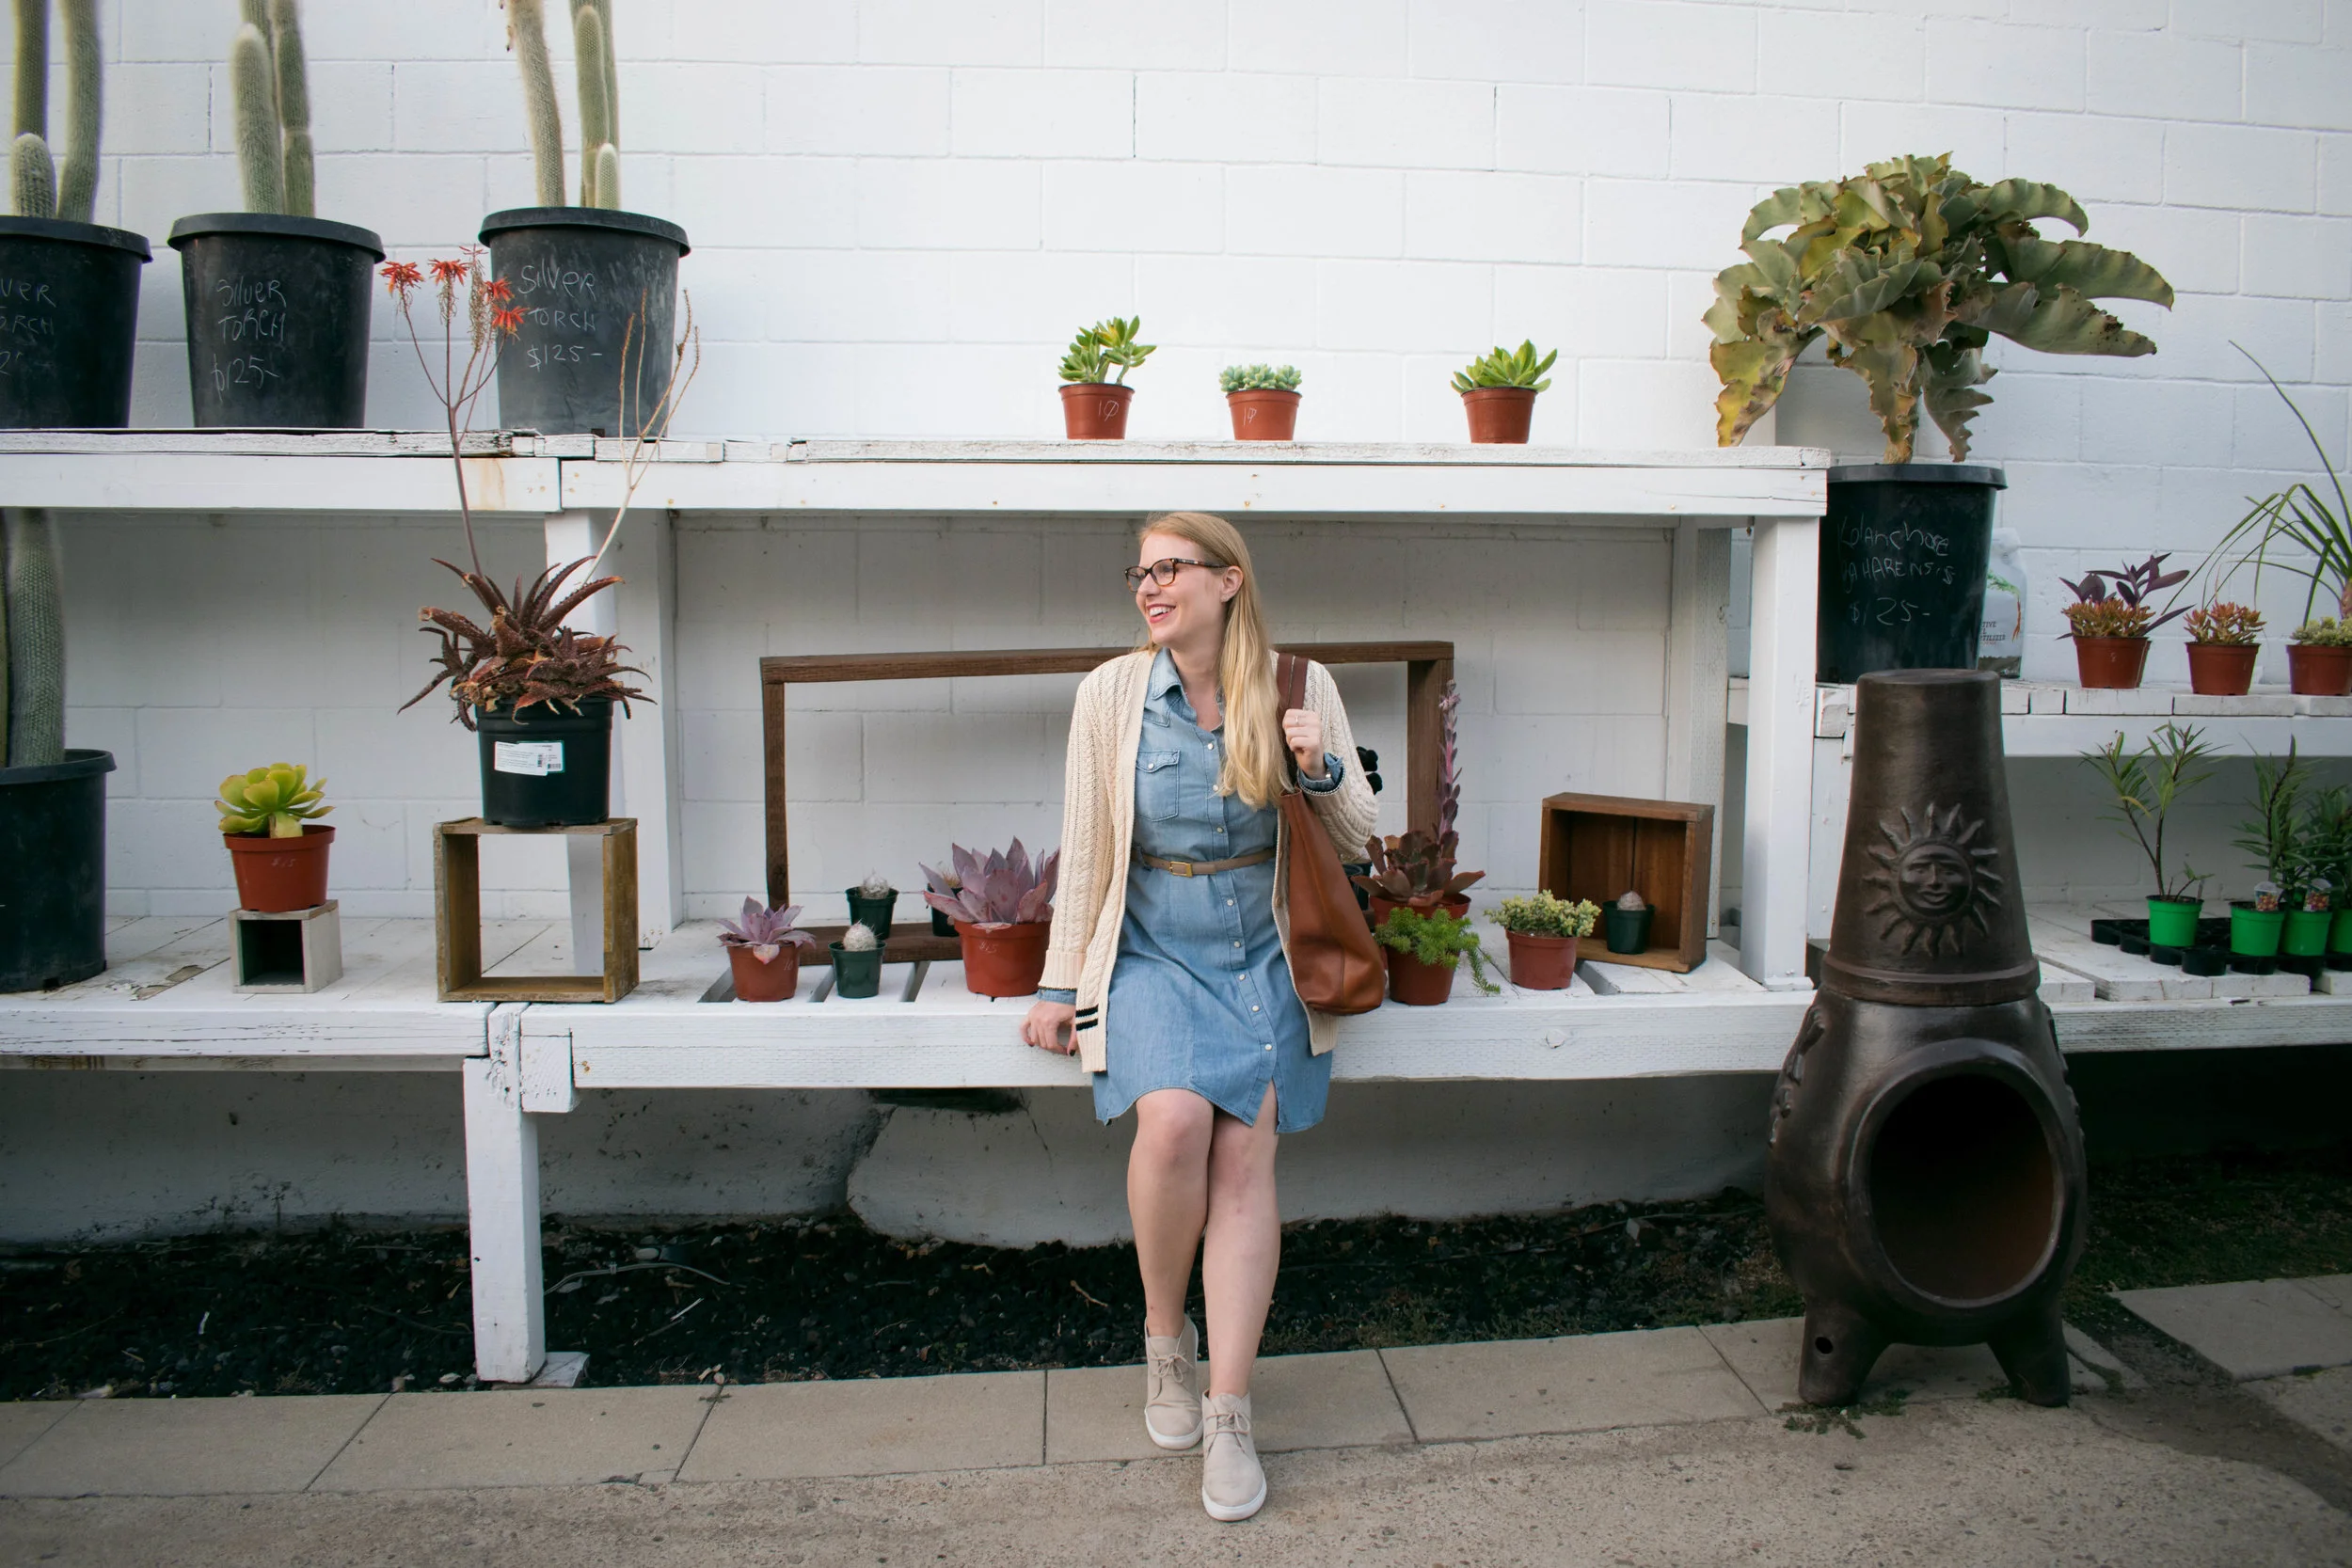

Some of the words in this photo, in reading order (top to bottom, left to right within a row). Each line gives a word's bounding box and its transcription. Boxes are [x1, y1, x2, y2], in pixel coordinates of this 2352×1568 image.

[0, 306, 55, 335] ORCH
[217, 309, 286, 344] TORCH
[528, 307, 596, 330] TORCH
